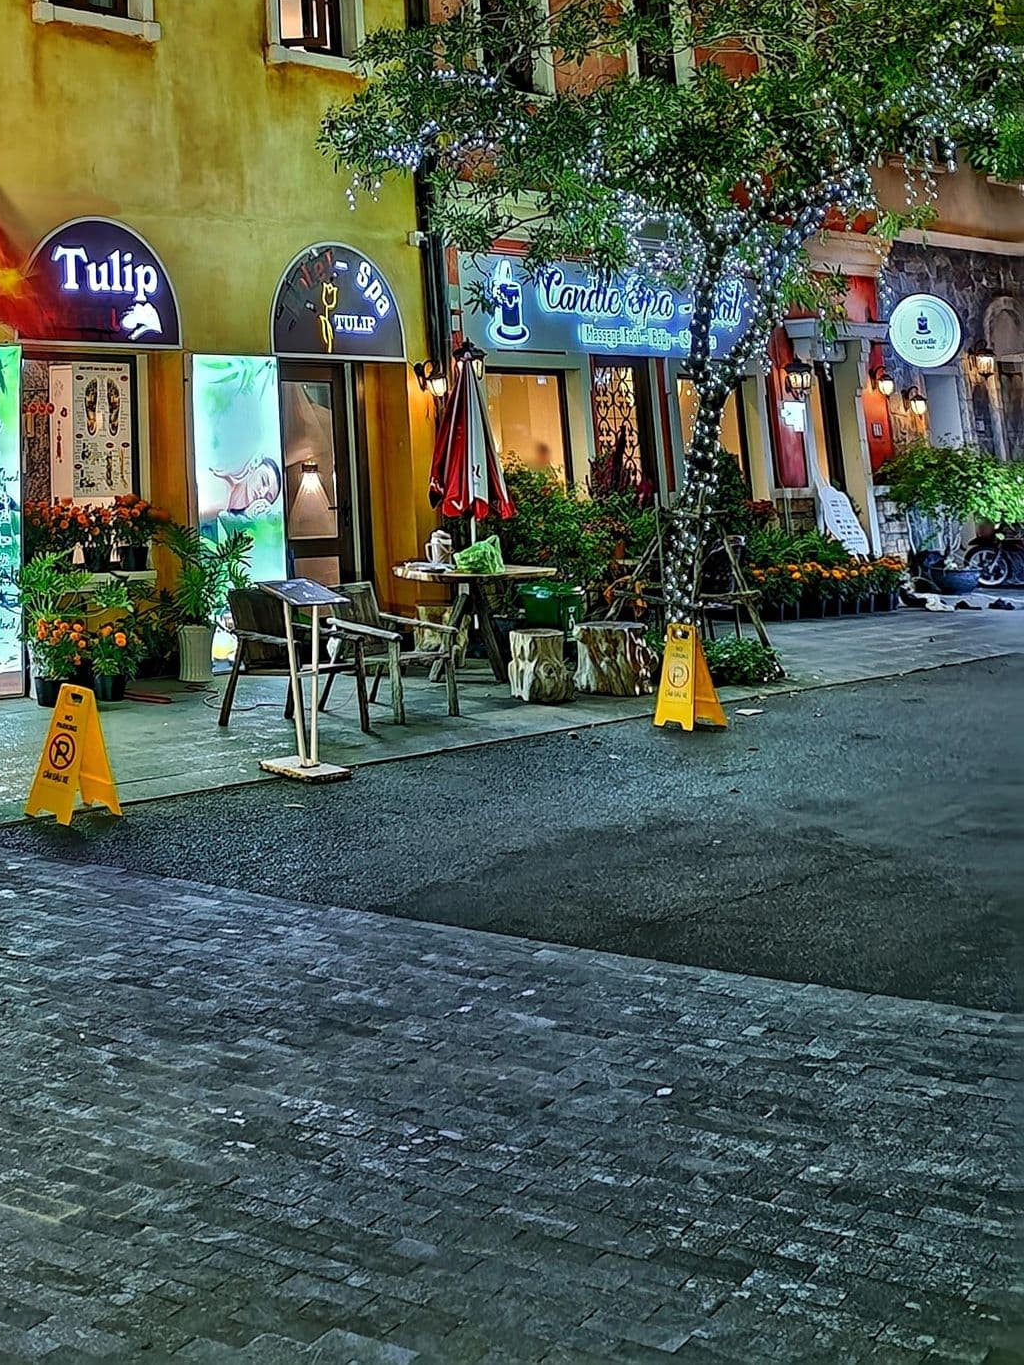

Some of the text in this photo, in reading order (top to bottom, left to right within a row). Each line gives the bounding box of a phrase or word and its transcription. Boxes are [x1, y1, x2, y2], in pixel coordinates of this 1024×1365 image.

[51, 245, 158, 302] Tulip
[356, 261, 390, 316] Spa
[541, 268, 622, 314] Candle
[334, 315, 376, 332] TULIP
[585, 325, 621, 346] Massage
[624, 327, 641, 343] Foot
